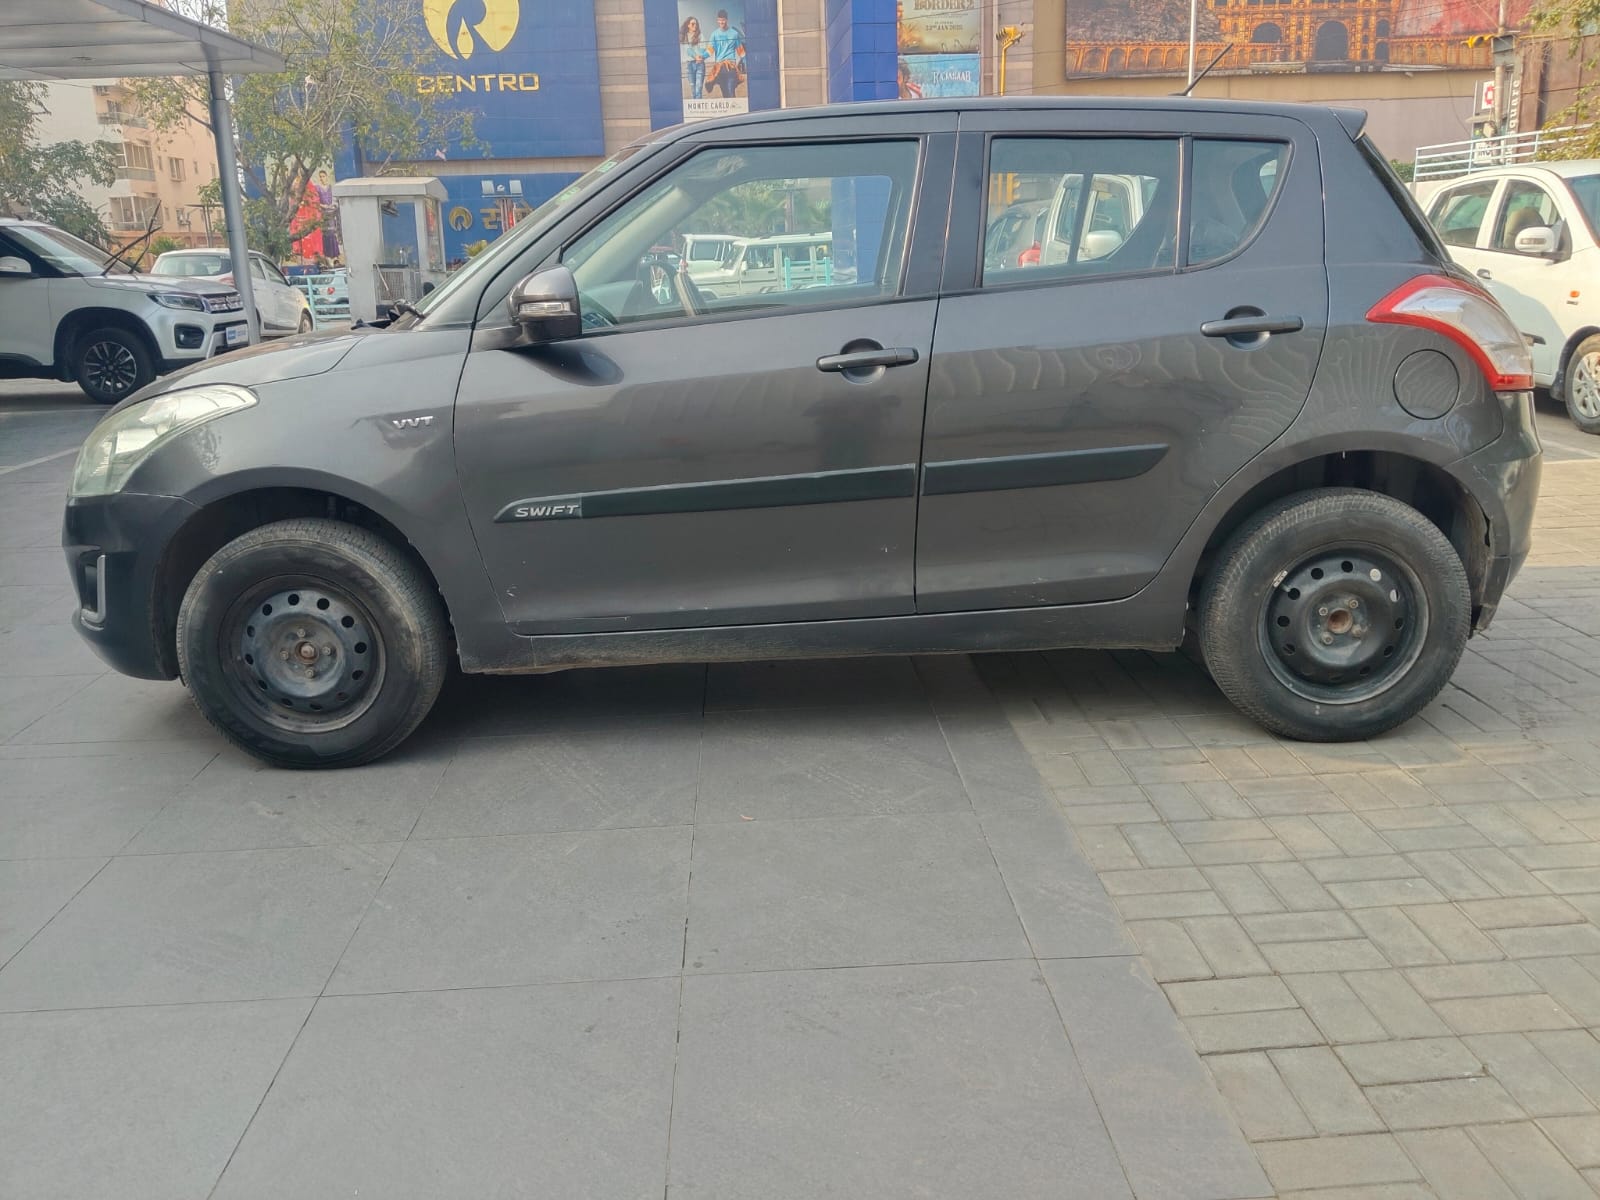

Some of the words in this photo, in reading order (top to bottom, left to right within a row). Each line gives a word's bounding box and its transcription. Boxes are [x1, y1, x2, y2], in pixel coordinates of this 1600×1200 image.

[416, 73, 540, 93] CENTRO
[688, 102, 709, 110] MONTE
[711, 101, 730, 110] CARLO
[392, 415, 434, 429] VVT
[515, 504, 579, 517] SWIFT
